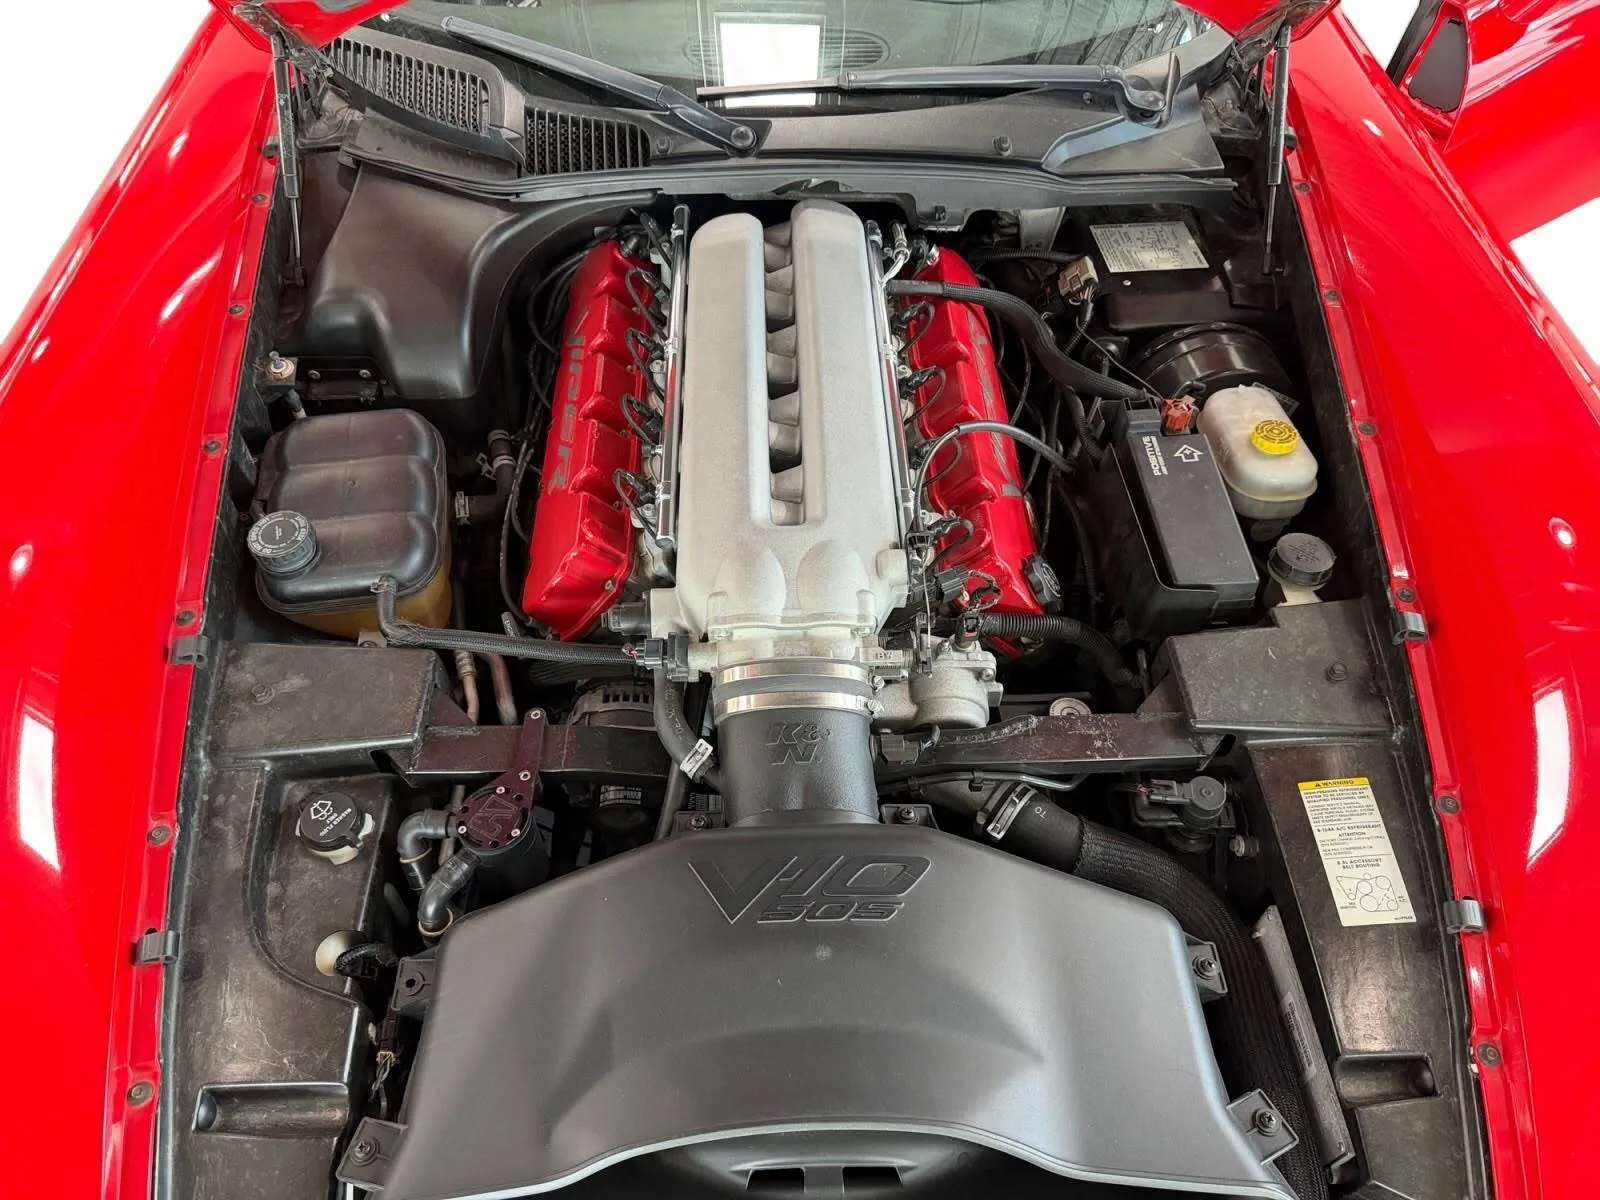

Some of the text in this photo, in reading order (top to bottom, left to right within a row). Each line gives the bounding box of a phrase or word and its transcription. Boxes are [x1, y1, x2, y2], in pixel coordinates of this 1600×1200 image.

[548, 305, 590, 494] VIPER
[1141, 435, 1161, 476] POSITIVE
[332, 807, 352, 825] WASHER
[757, 900, 905, 924] 505
